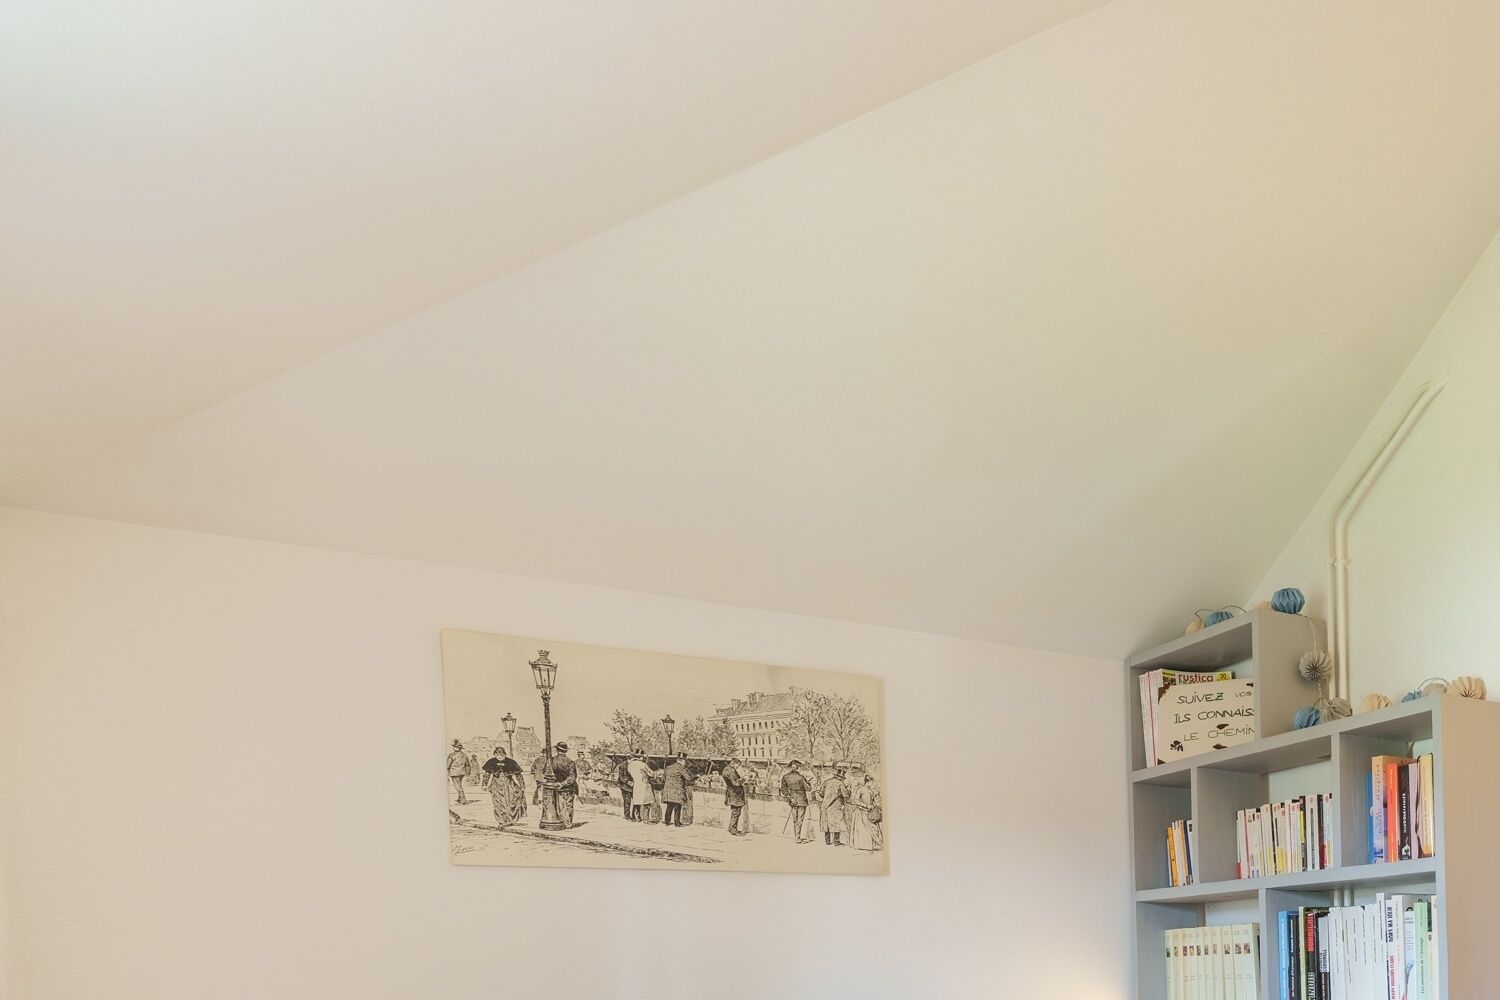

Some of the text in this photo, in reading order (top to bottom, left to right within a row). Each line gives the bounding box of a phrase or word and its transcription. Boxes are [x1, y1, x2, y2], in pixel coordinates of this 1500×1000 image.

[1178, 673, 1214, 683] rustica
[1177, 691, 1225, 705] SUIVEZ
[1173, 713, 1191, 724] ILS
[1183, 731, 1200, 742] LE
[1387, 919, 1393, 927] MA
